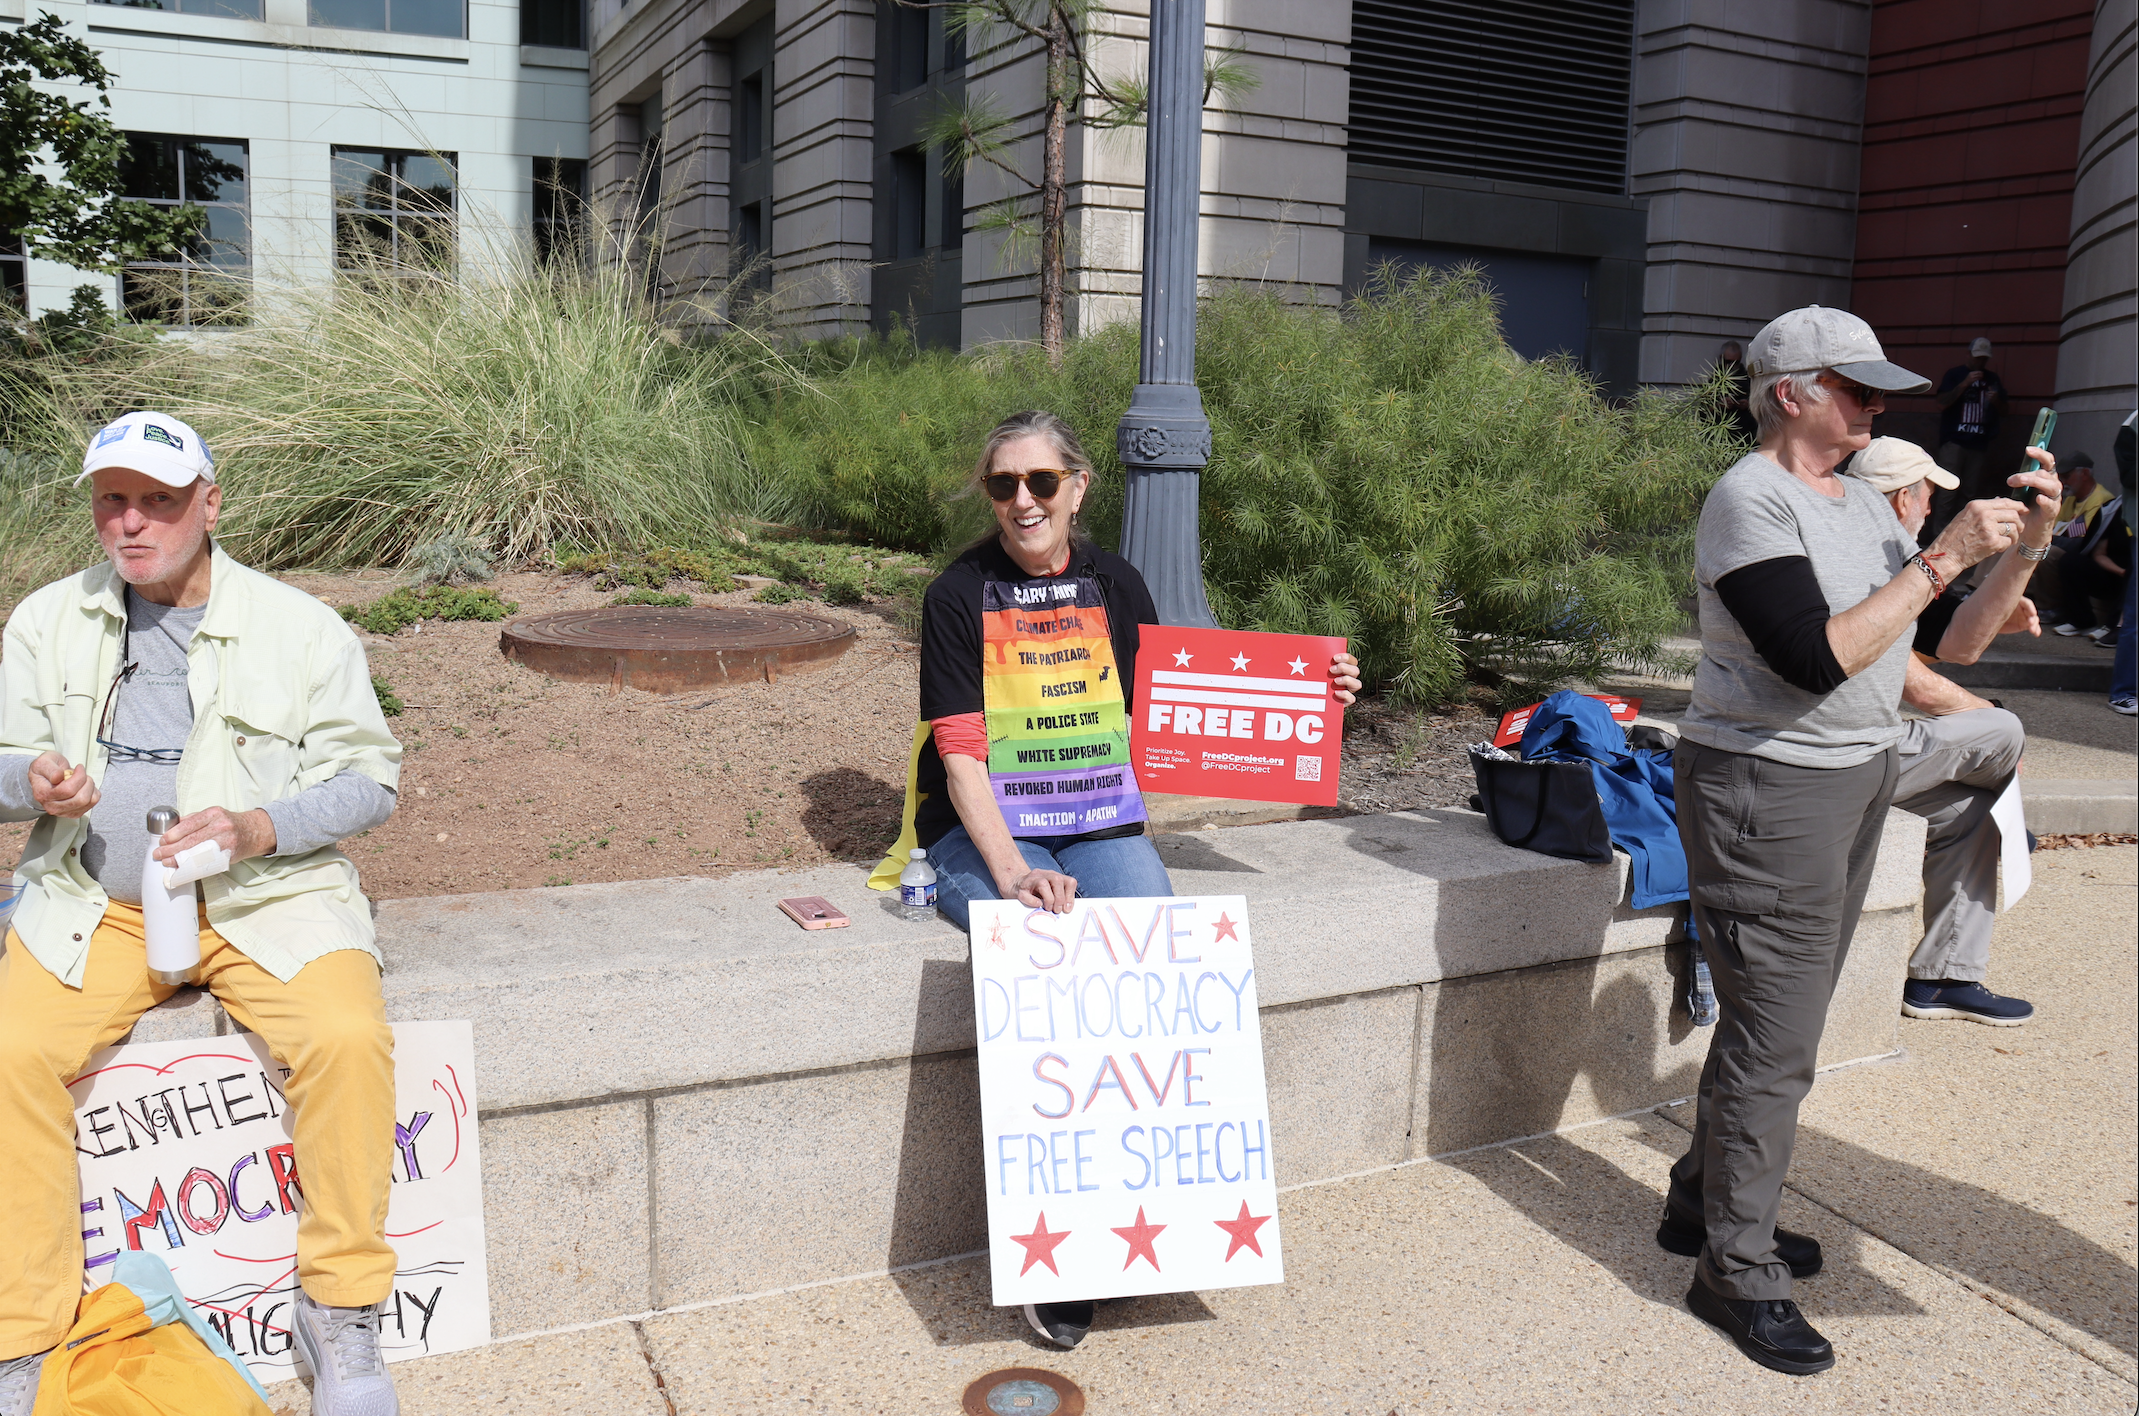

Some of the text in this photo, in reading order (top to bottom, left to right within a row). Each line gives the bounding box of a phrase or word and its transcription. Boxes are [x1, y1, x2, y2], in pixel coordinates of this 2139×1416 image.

[1018, 652, 1038, 665] THE
[1041, 680, 1087, 698] FASCISM
[1026, 711, 1099, 730] A POLICE STATE
[1147, 703, 1324, 744] FREE DC
[1016, 742, 1112, 763] WHITE SUPREMACY
[1145, 746, 1174, 755] Prioritize
[1171, 756, 1192, 764] Space.
[1202, 751, 1285, 766] FreeDCproject.org
[1144, 761, 1177, 770] Organize.
[1201, 761, 1271, 774] @FreeDCproject
[1004, 773, 1123, 796] REVOKED HUMAN RIGHTS
[1018, 812, 1076, 827] INACTION
[1085, 805, 1118, 822] APATHY
[1022, 902, 1202, 970] SAVE
[980, 968, 1253, 1043] DEMOCRACY
[1032, 1047, 1212, 1120] SAVE
[997, 1119, 1267, 1196] FREE SPEECH
